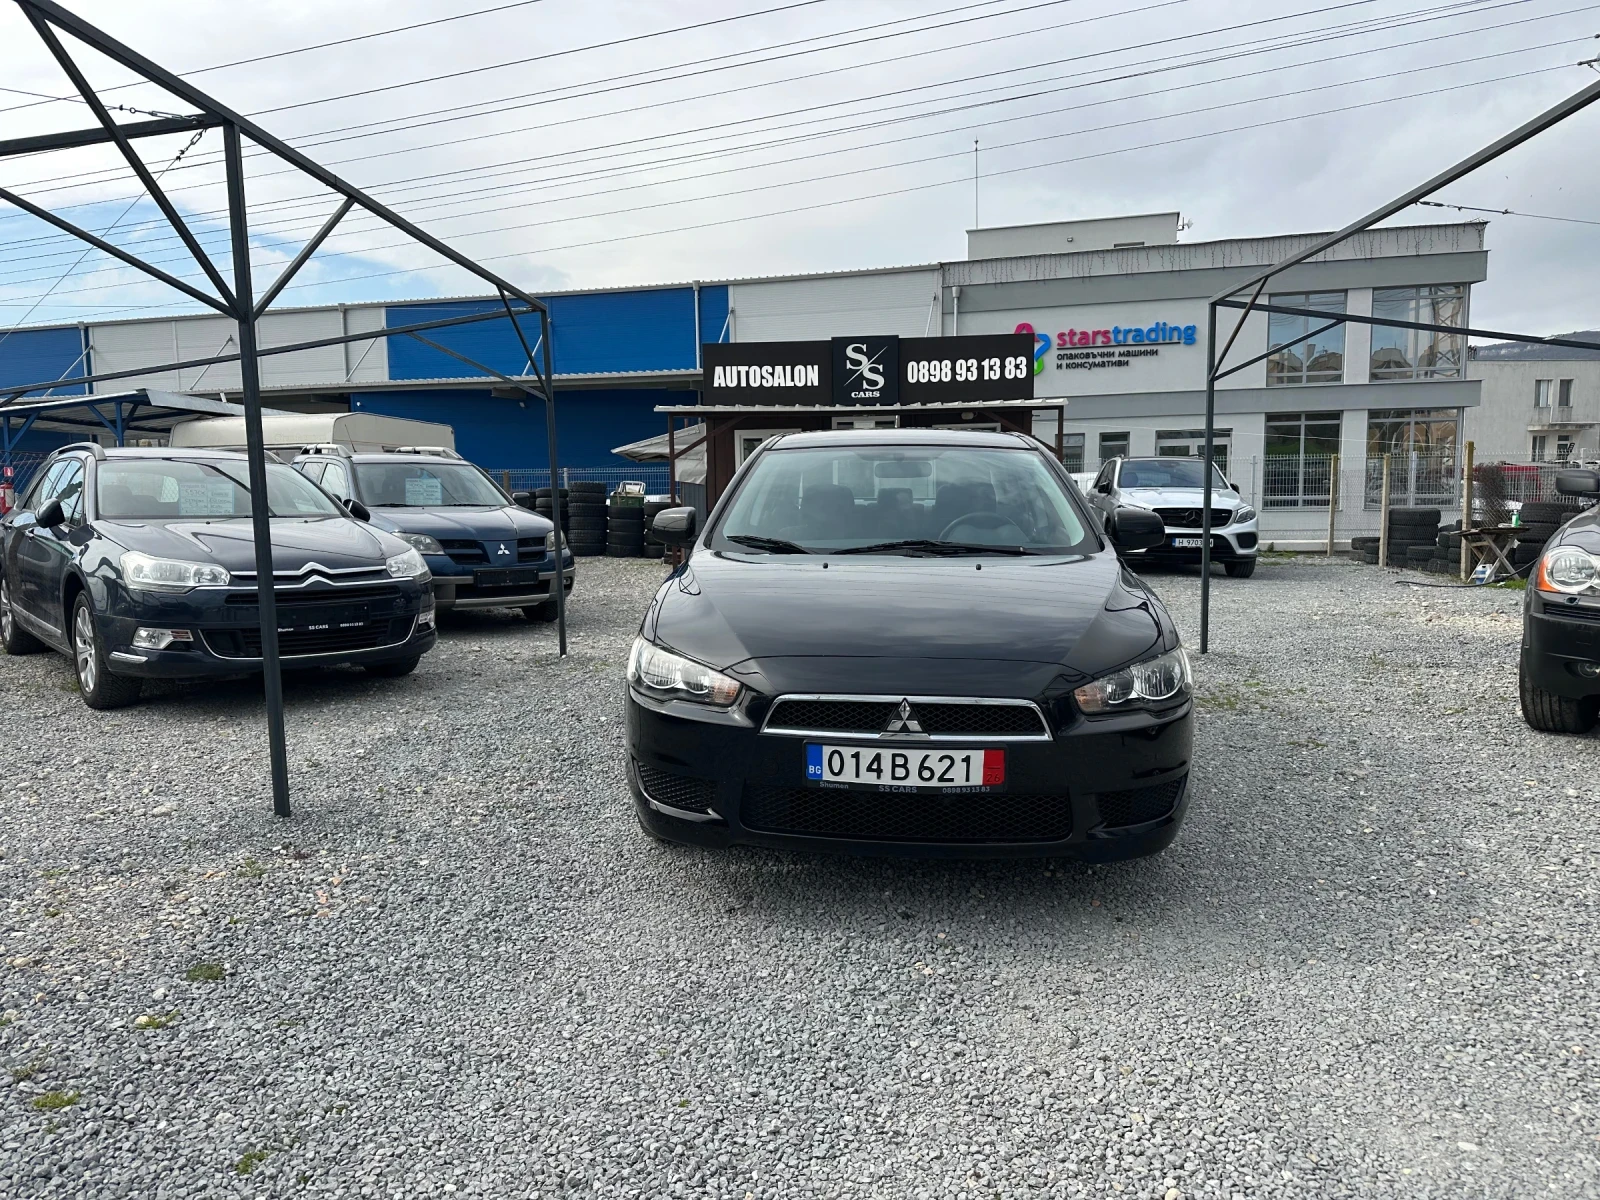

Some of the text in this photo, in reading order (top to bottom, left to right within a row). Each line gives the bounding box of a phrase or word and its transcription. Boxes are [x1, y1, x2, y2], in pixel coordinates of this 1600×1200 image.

[1057, 322, 1196, 347] starstrading
[1056, 348, 1158, 361] опаковъчни машини
[907, 356, 1027, 384] 0898 93 13 83
[1056, 359, 1129, 370] и консумативи
[713, 364, 819, 388] AUTOSALON
[808, 765, 822, 775] BG
[819, 781, 849, 789] Shumen
[892, 785, 918, 793] CARS
